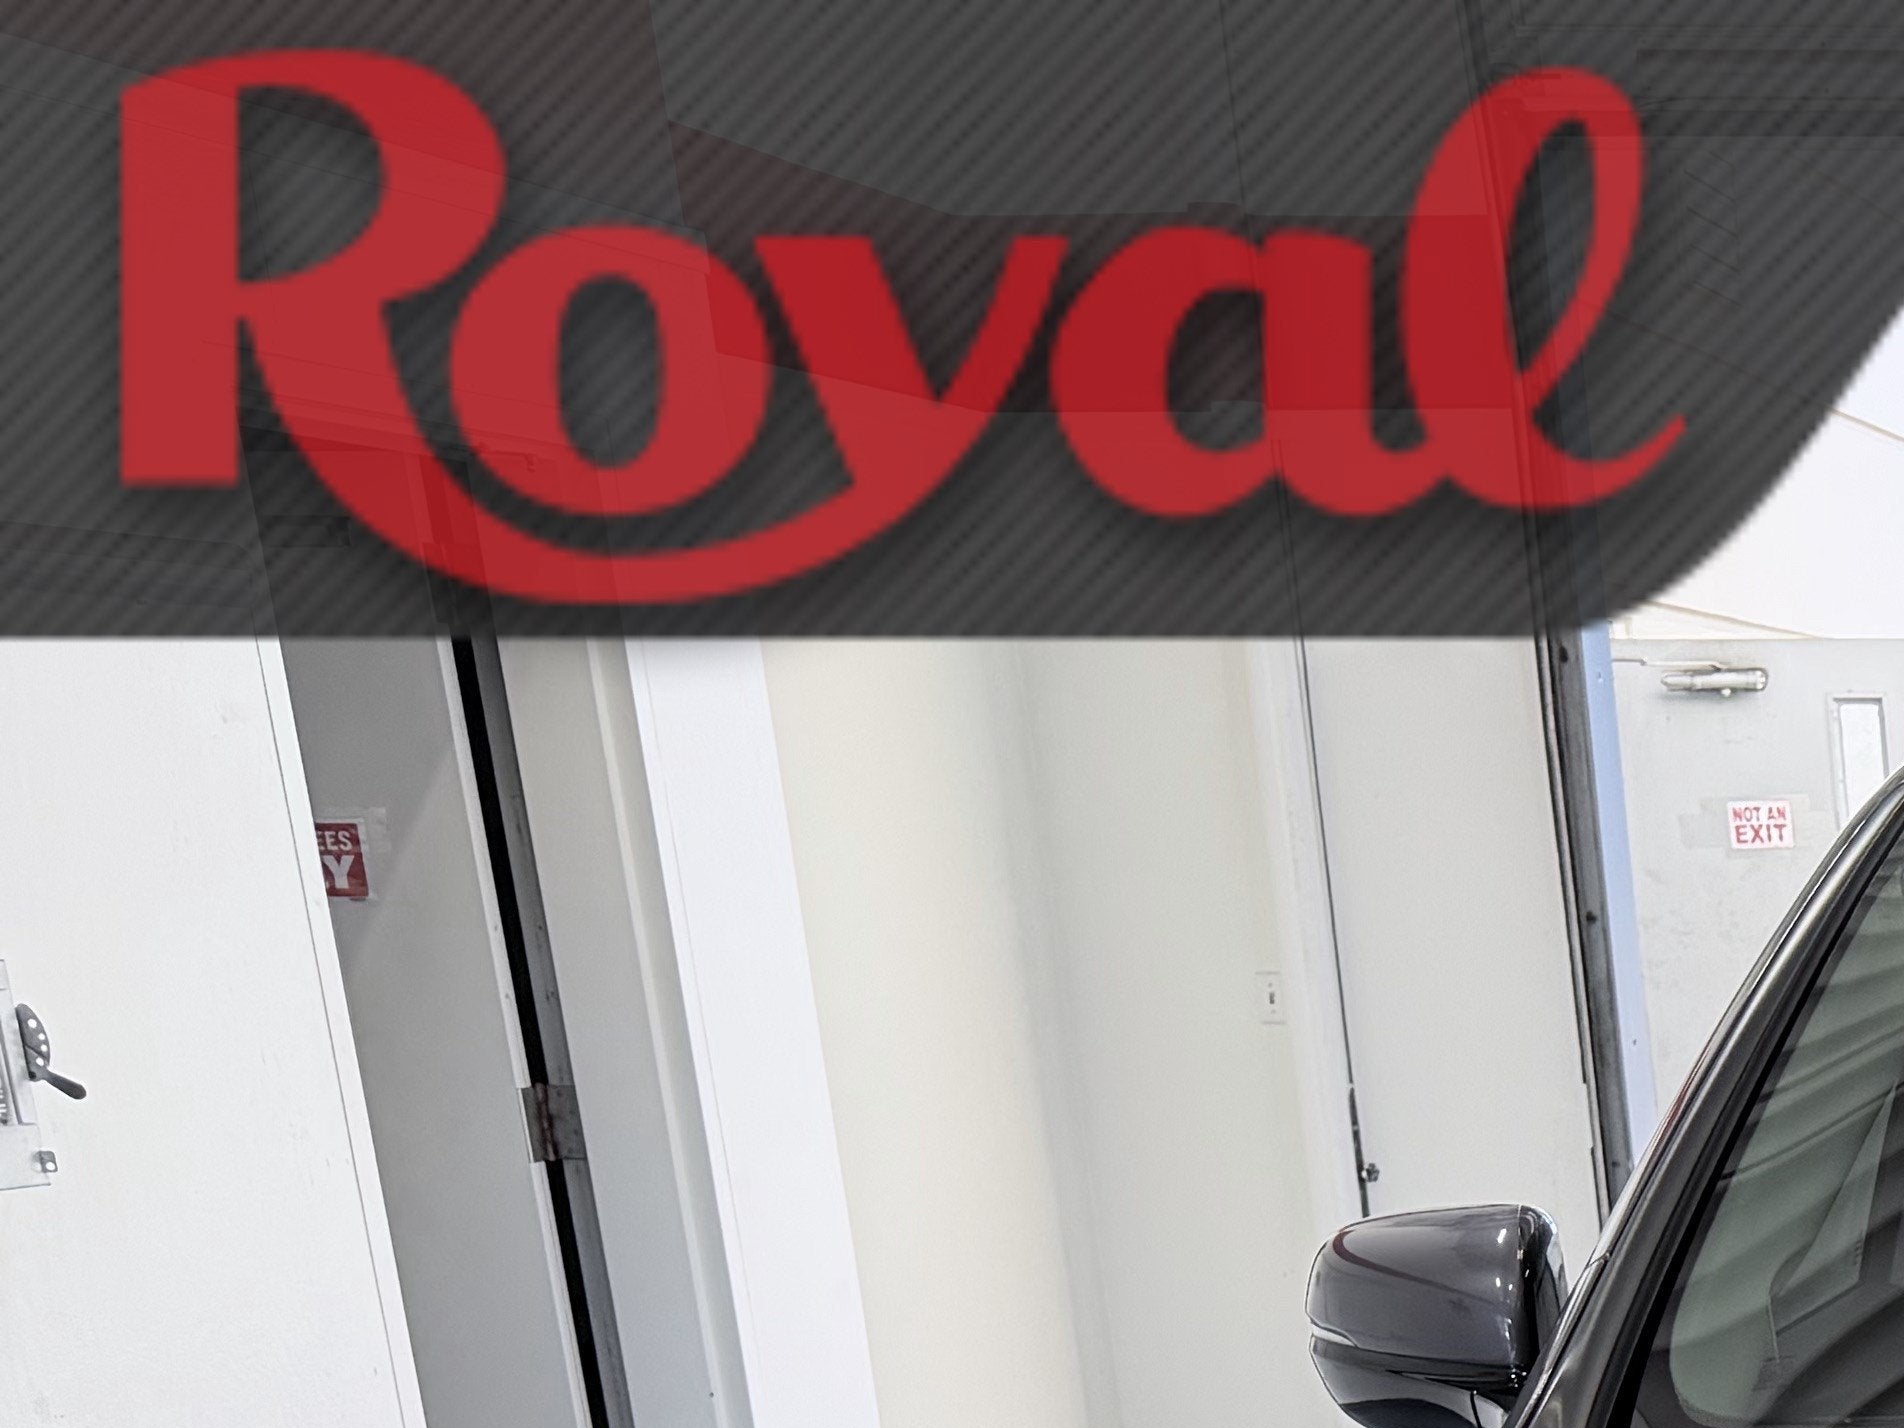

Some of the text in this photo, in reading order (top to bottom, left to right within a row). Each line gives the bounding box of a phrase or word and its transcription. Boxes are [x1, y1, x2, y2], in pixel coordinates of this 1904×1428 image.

[1732, 806, 1786, 822] NOT AN
[1735, 823, 1787, 844] EXIT
